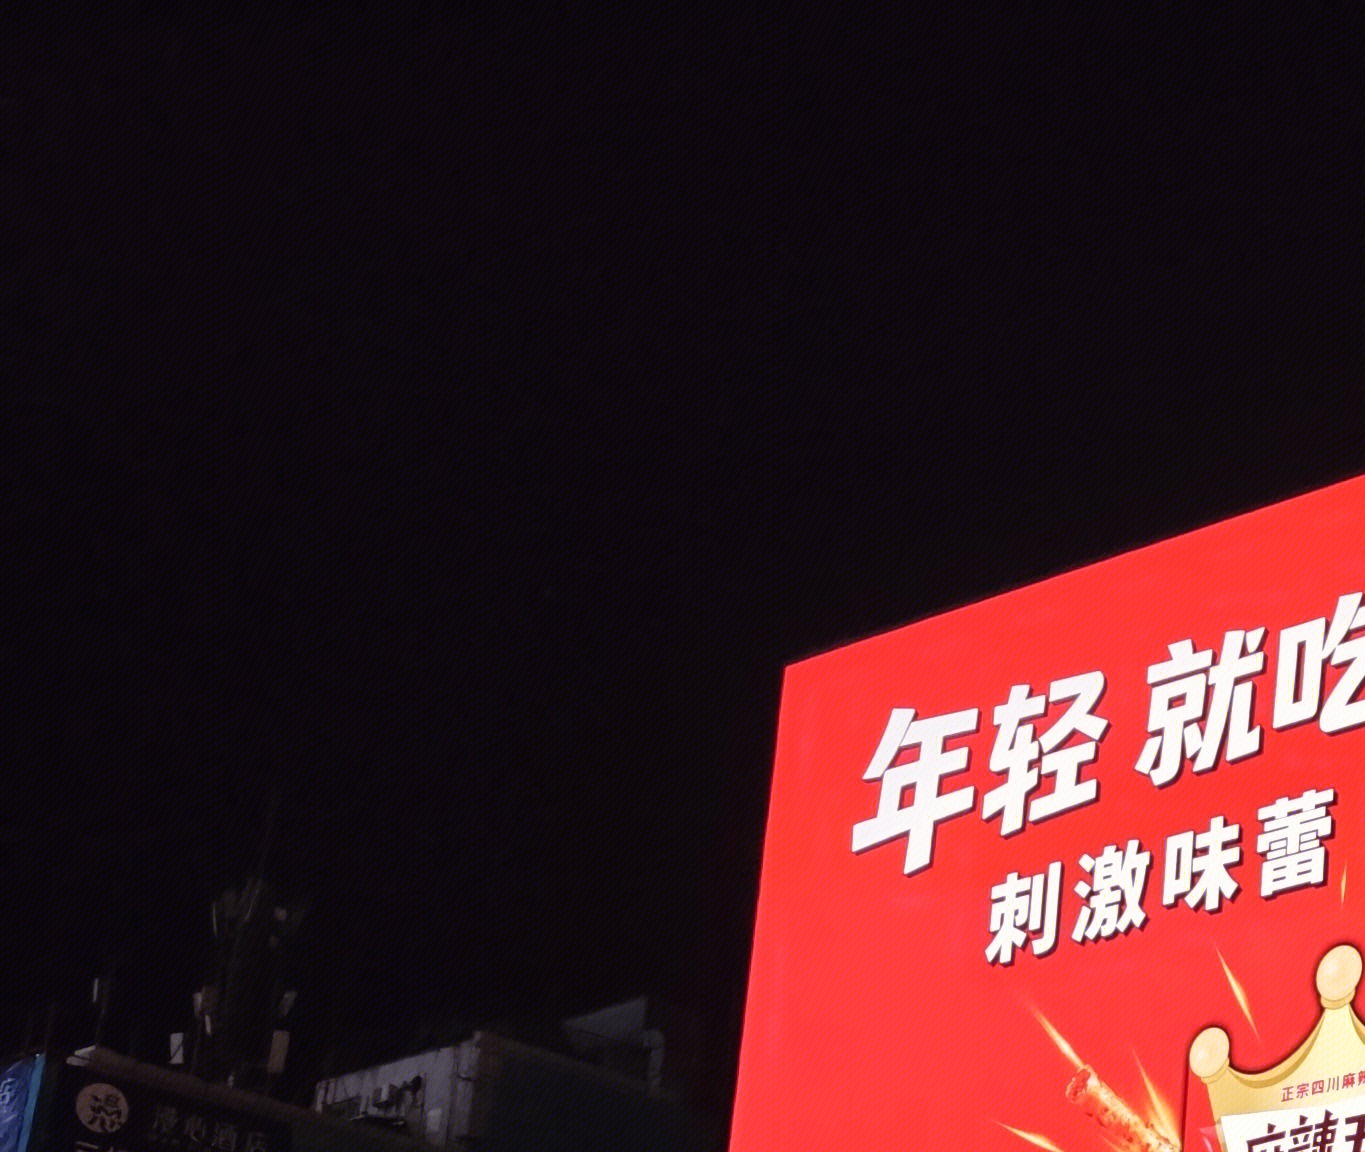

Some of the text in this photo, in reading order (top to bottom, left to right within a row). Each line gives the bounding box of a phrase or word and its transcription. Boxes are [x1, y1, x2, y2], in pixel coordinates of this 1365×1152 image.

[850, 669, 1109, 878] 年轻
[984, 786, 1338, 966] 刺激味蕾
